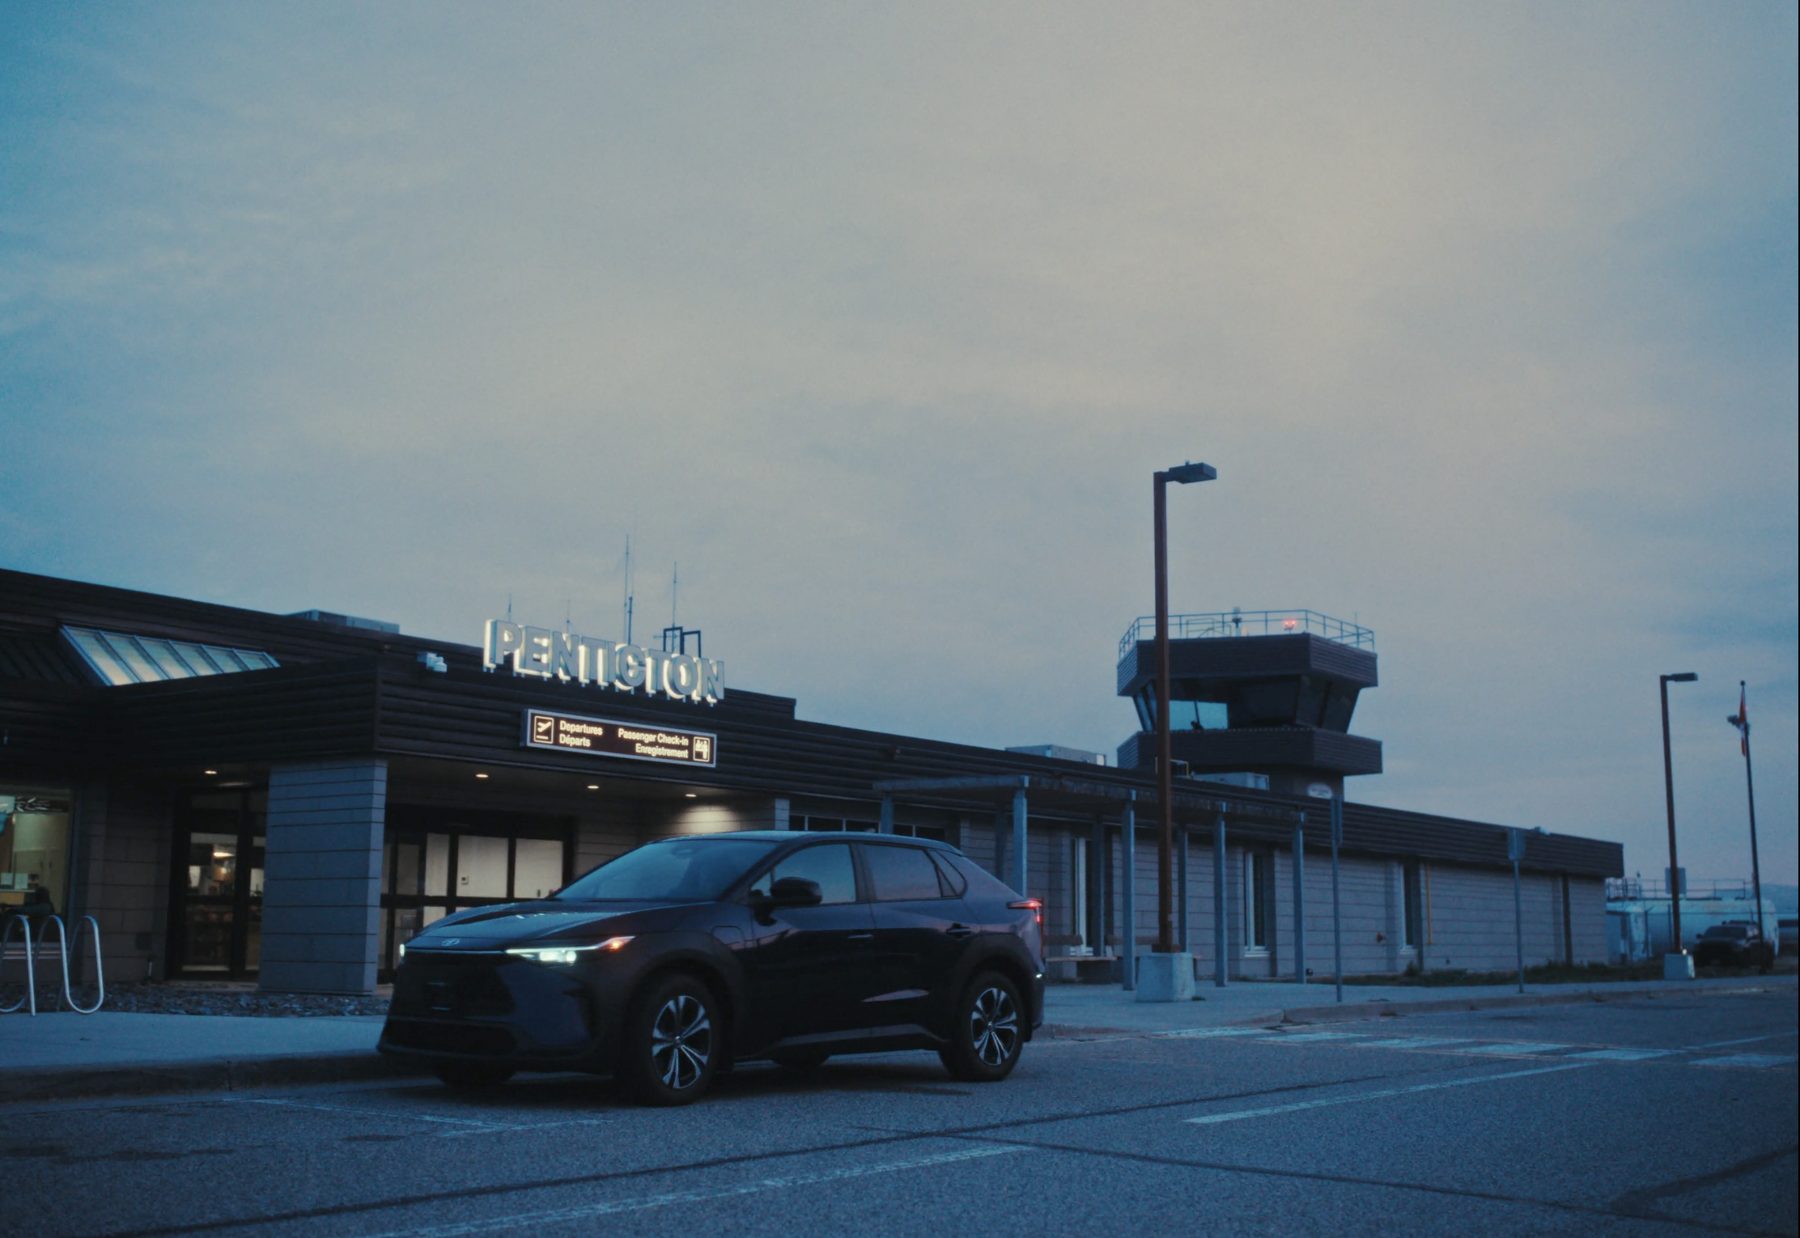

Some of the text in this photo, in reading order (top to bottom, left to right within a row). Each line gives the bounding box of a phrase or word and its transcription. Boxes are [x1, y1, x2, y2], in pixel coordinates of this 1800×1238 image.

[482, 618, 725, 704] PENTICTON
[559, 720, 603, 736] Departures
[559, 733, 591, 747] Départs
[617, 727, 689, 746] Passenger Check-in
[635, 743, 689, 759] Enregistrement
